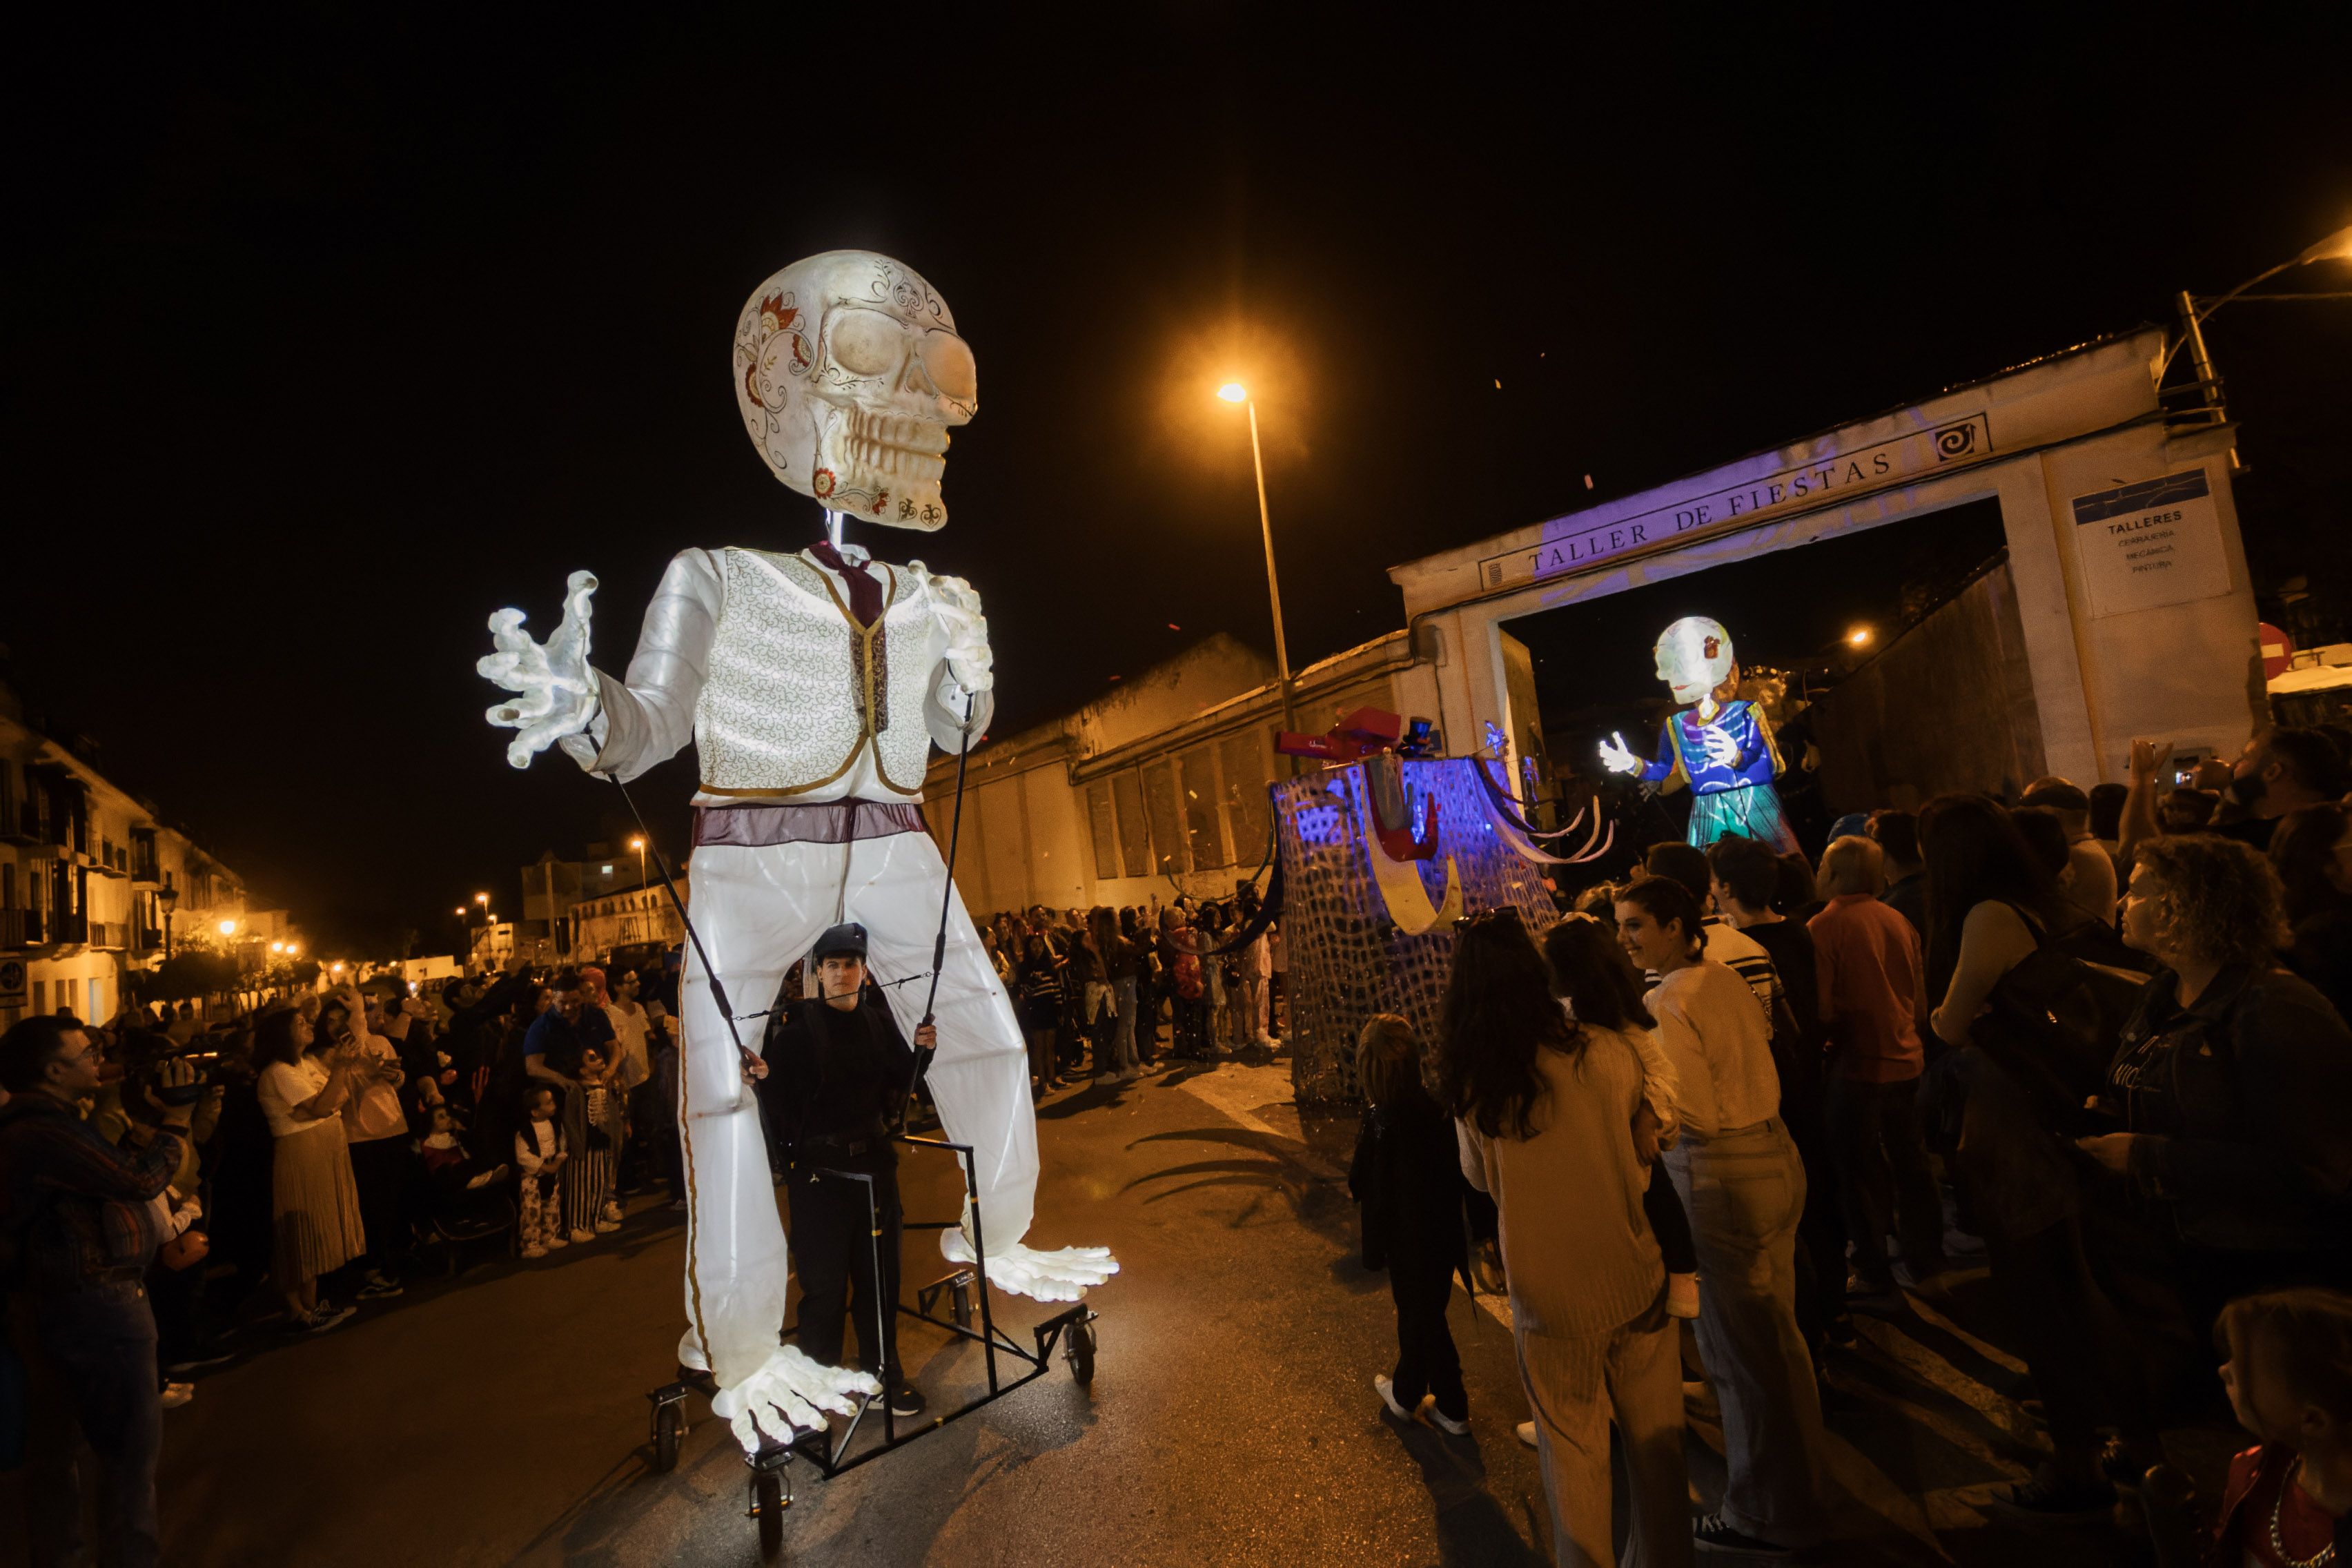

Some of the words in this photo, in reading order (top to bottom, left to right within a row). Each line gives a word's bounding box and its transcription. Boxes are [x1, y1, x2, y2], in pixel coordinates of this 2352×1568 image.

[1528, 524, 1647, 571] TALLER
[1676, 504, 1712, 531] DE
[1727, 453, 1890, 516] FIESTAS
[2108, 511, 2182, 535] TALLERES
